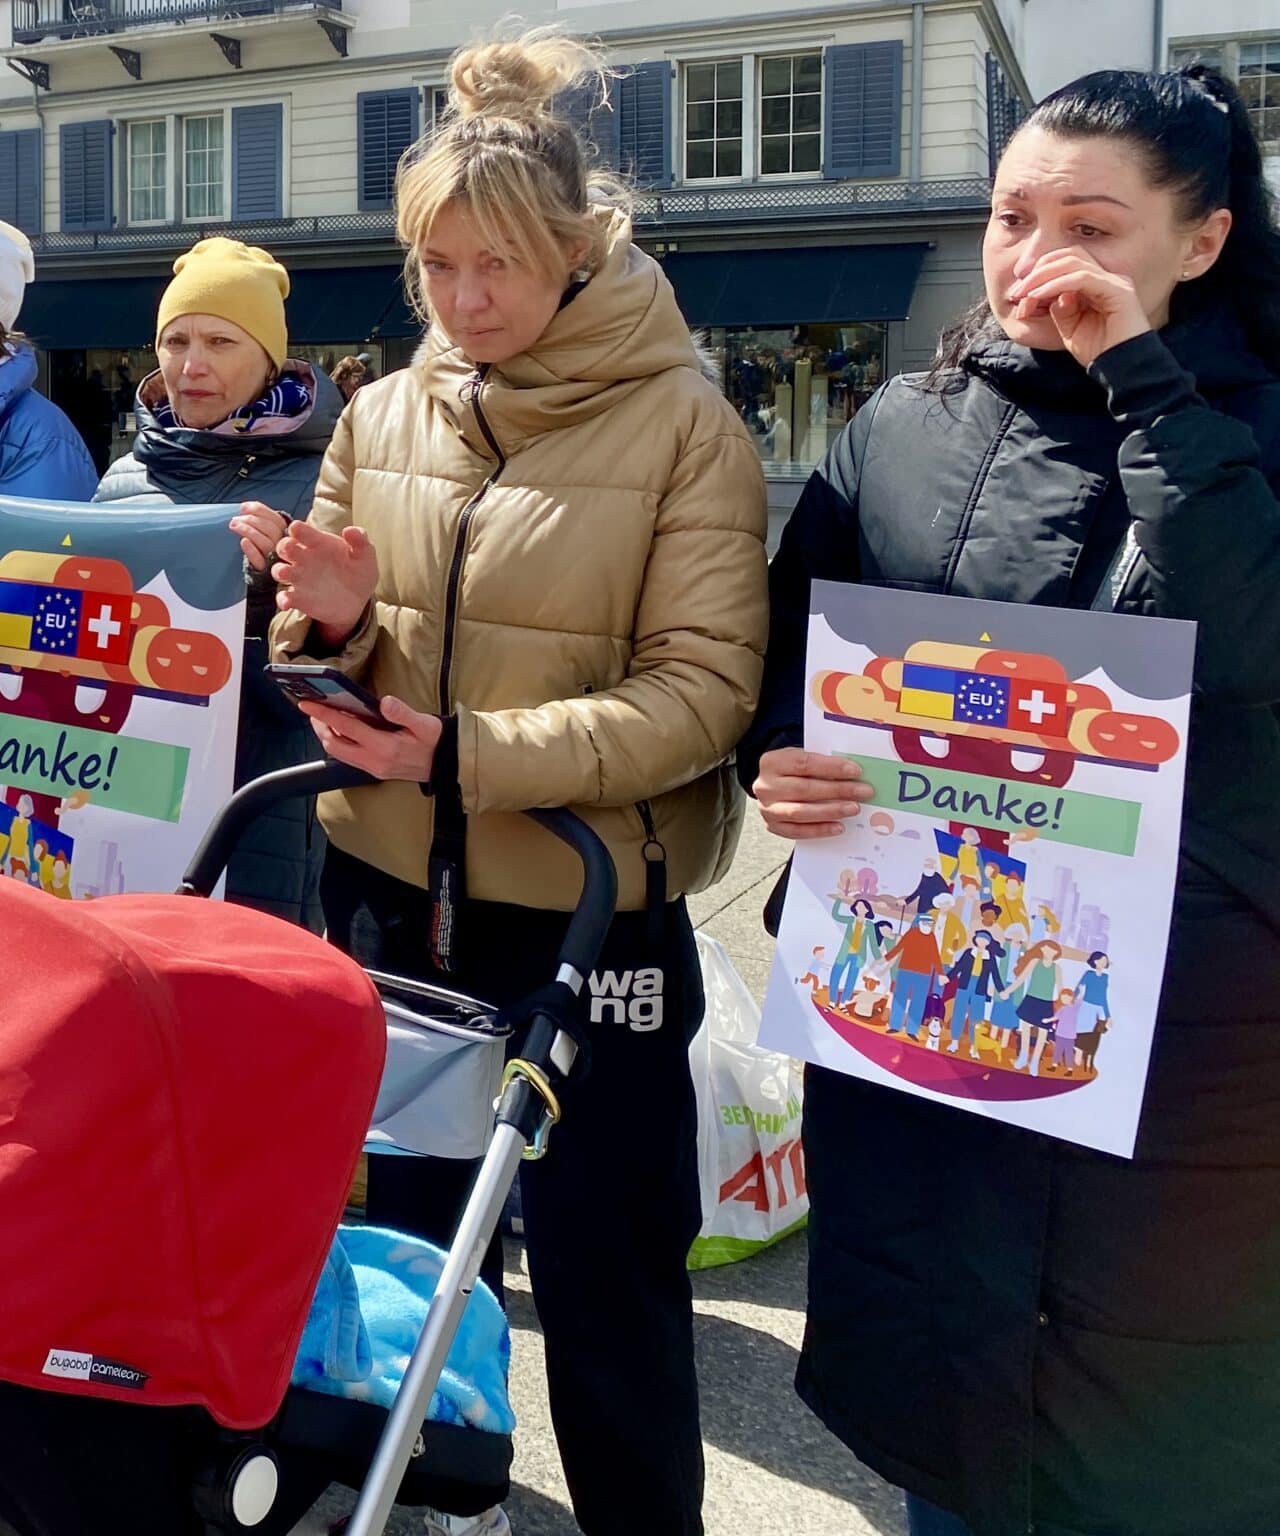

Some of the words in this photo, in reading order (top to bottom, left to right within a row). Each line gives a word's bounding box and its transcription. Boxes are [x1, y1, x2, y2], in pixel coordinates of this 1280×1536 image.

[45, 613, 67, 629] EU
[969, 693, 993, 707] EU
[897, 770, 1064, 830] Danke!
[588, 968, 664, 996] wa
[590, 995, 664, 1031] ng
[92, 1363, 140, 1381] cameleon
